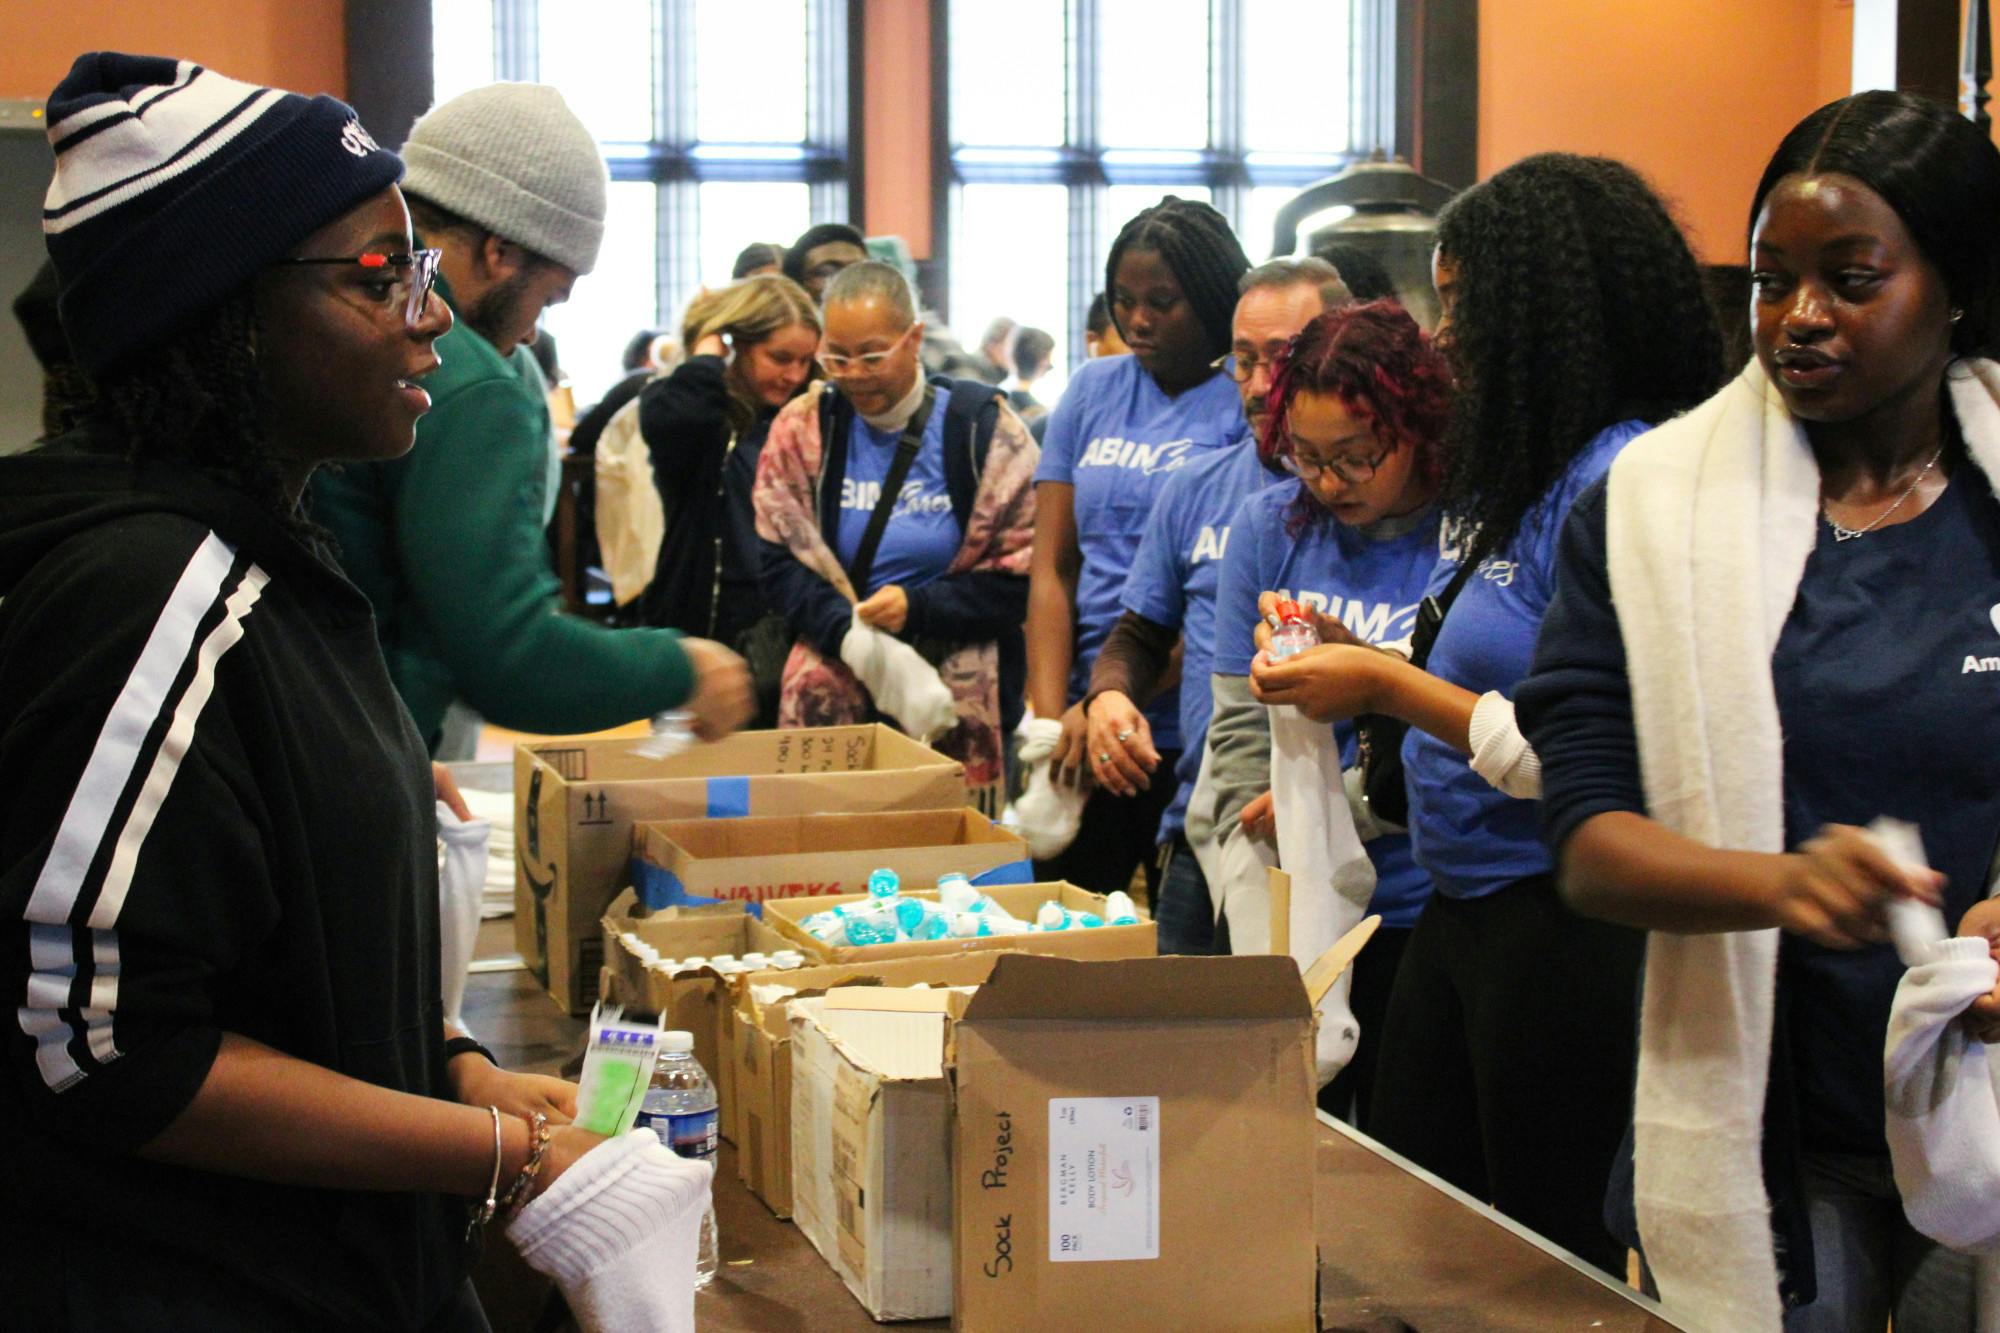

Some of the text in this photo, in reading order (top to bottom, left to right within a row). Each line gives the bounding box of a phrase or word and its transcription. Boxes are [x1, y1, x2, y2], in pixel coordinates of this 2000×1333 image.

[840, 477, 882, 511] BIM
[980, 1110, 1013, 1278] Sock Project
[1087, 1150, 1095, 1209] BODY LOTION
[1060, 1234, 1071, 1251] 100
